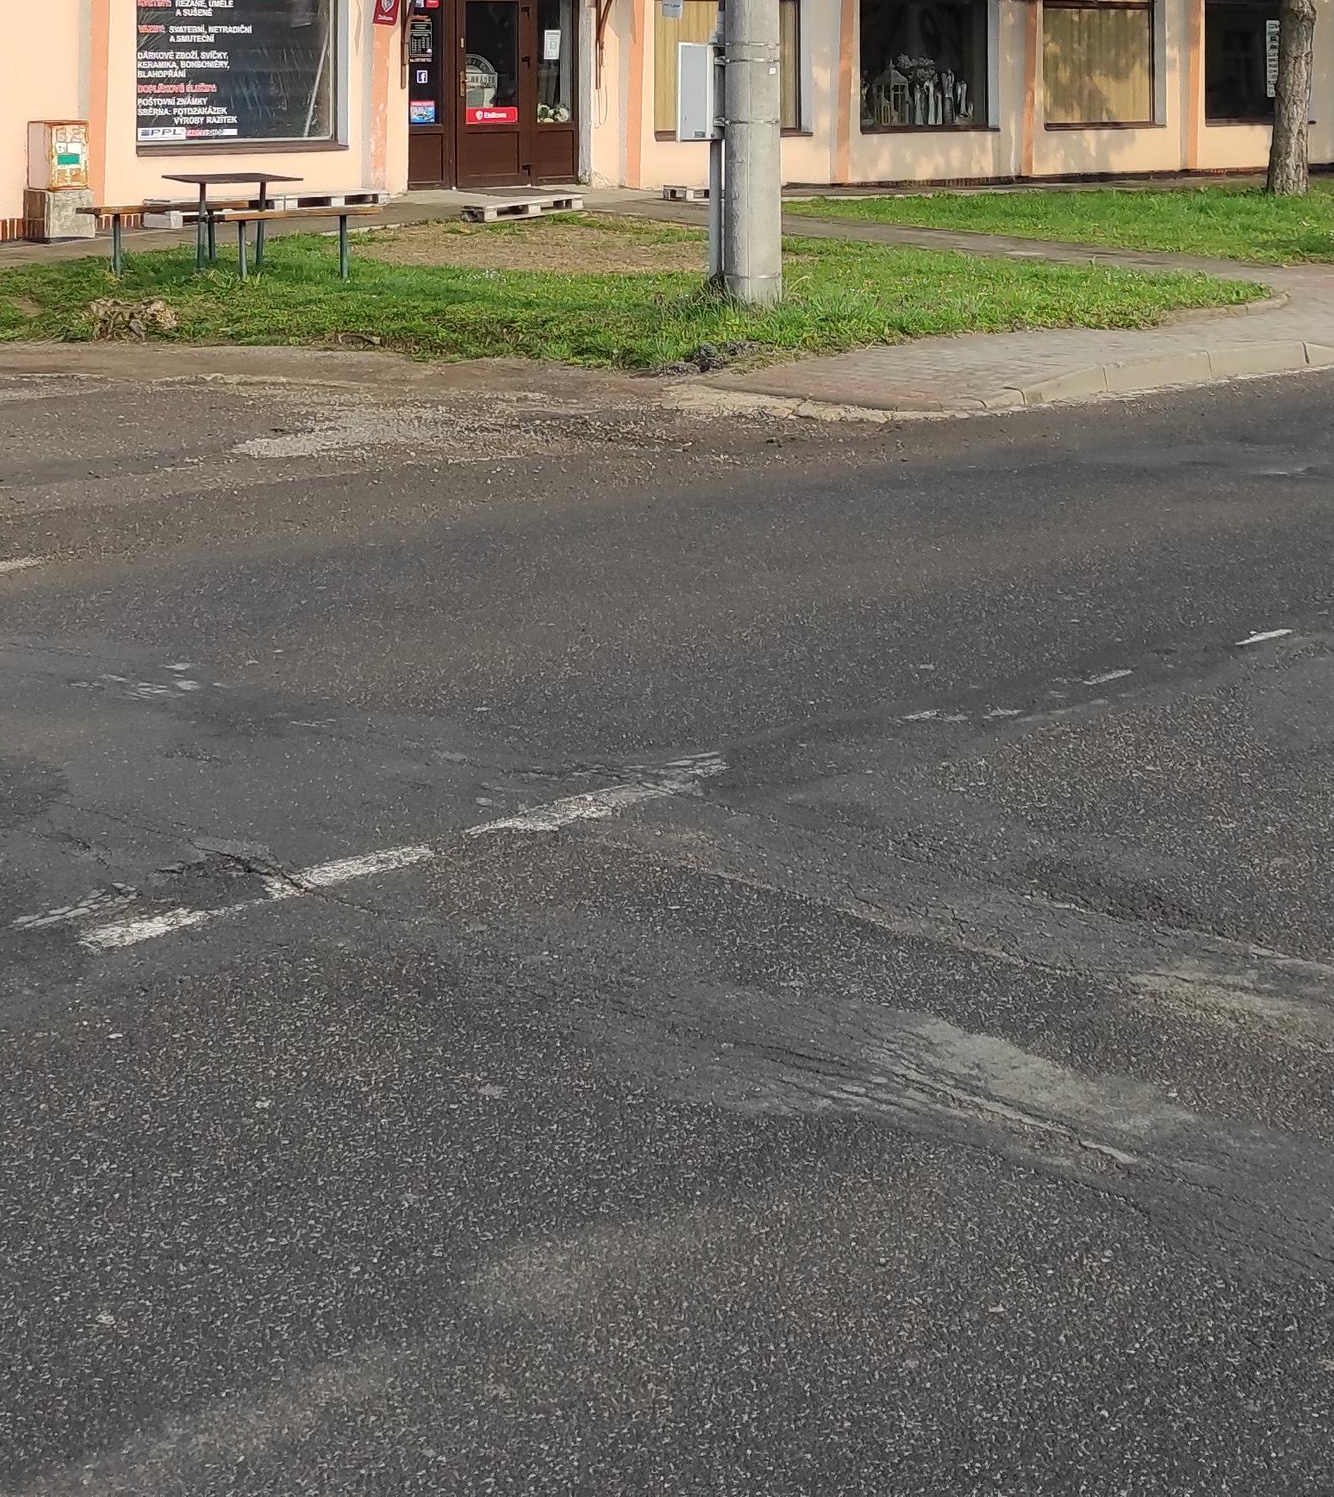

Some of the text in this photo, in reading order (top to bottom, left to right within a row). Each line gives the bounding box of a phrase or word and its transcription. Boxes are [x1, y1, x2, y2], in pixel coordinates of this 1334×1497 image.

[175, 9, 182, 17] A
[169, 35, 175, 43] A
[137, 50, 174, 60] DÁRKOVÉ
[137, 96, 208, 106] POŠTOVNÍ ZNÁMKY
[174, 115, 238, 125] VÝROBY RAZÍTEK
[150, 128, 183, 137] PPL
